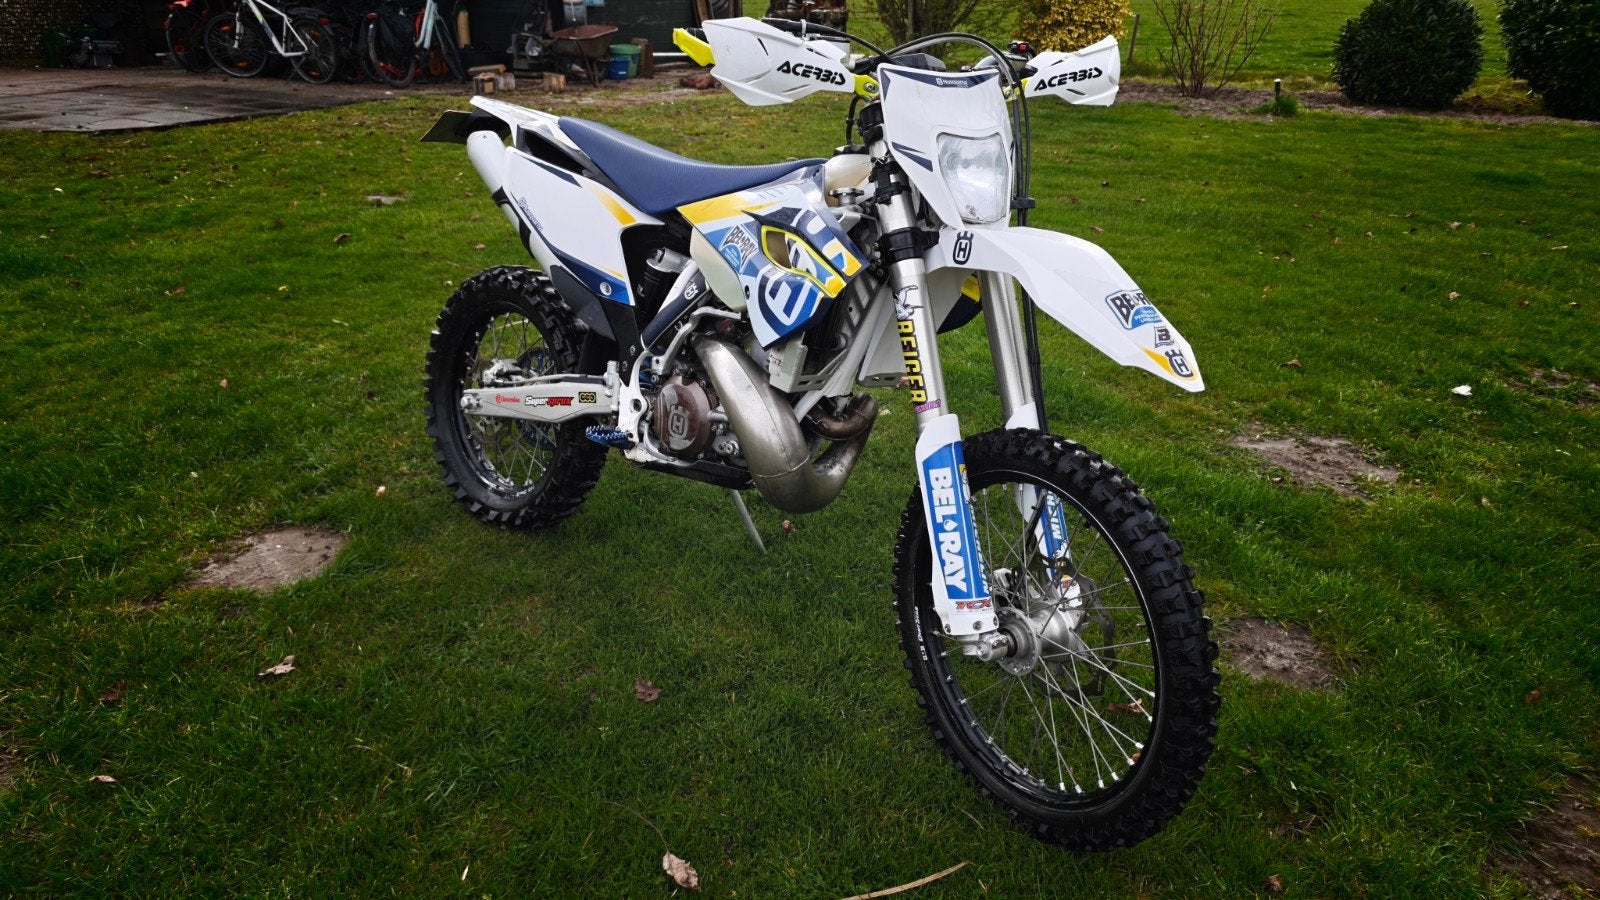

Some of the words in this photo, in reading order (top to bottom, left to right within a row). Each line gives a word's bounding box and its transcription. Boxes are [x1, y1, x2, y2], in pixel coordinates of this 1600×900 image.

[776, 60, 846, 86] ACERBIS
[1034, 66, 1103, 92] ACERBIS
[929, 467, 958, 524] BEL
[938, 532, 967, 594] RAY
